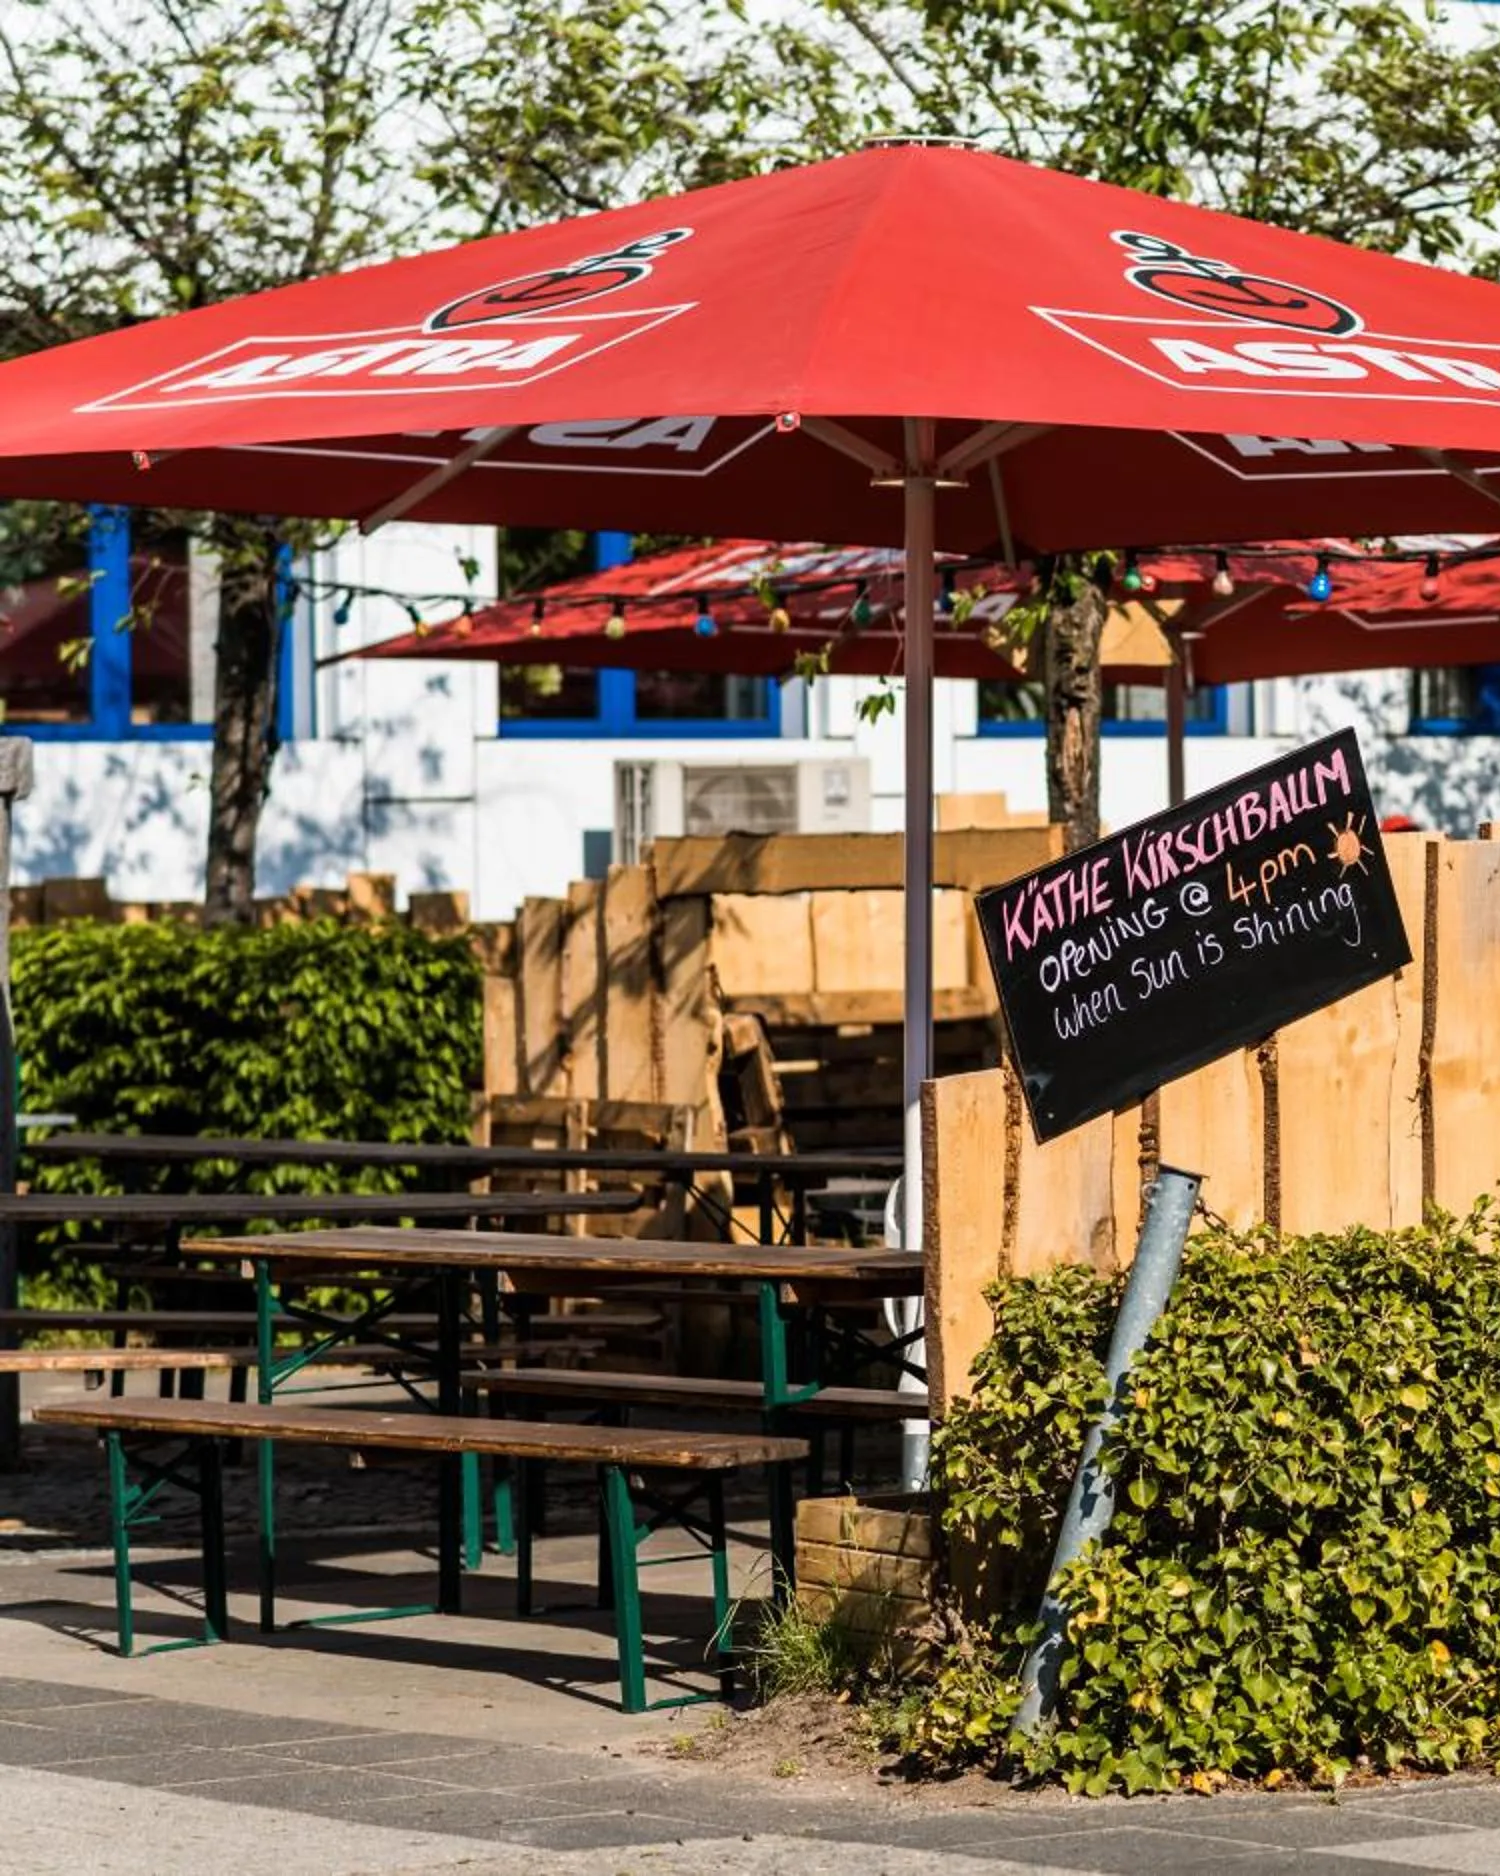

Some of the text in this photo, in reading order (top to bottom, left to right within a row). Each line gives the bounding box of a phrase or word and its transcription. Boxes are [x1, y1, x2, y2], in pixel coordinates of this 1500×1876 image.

[160, 334, 582, 392] ASTRA
[1003, 857, 1114, 962] KÄTHE
[1179, 881, 1213, 917] @
[1130, 949, 1190, 999] Sun
[1194, 930, 1224, 966] is
